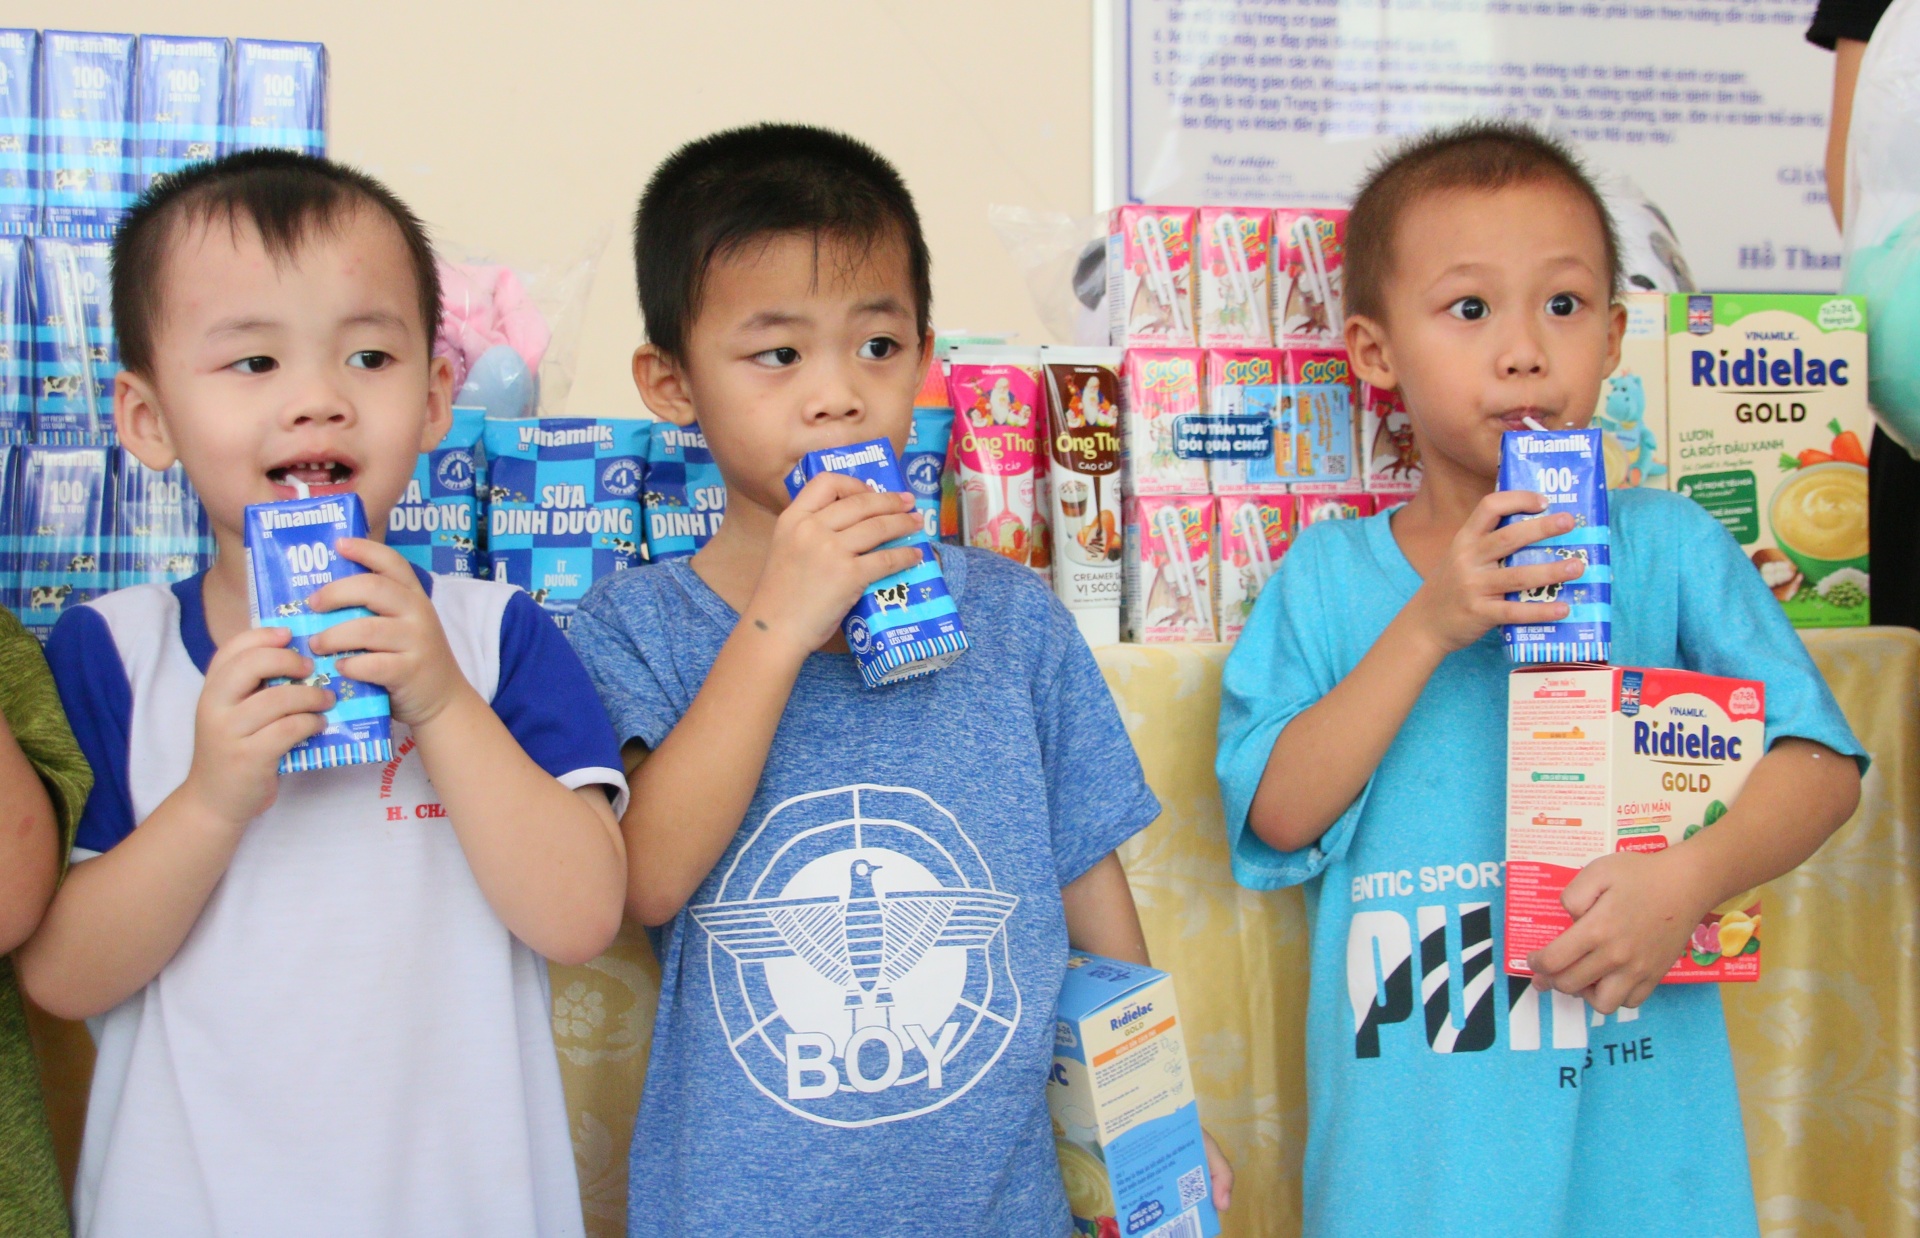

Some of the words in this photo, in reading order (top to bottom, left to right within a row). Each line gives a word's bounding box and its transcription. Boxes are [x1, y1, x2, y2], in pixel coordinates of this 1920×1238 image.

[53, 34, 124, 55] Vinamilk
[151, 39, 217, 58] Vinamilk
[246, 44, 313, 62] Vinamilk
[1691, 347, 1849, 387] Ridielac
[1735, 402, 1807, 423] GOLD
[518, 425, 613, 447] Vinamilk
[661, 430, 708, 448] Vina
[961, 430, 1004, 460] Ông
[1056, 430, 1098, 460] Ông
[1517, 434, 1592, 454] Vinamilk
[32, 451, 100, 467] Vinamilk
[821, 444, 887, 472] Vinamilk
[50, 480, 90, 504] 100%
[147, 481, 187, 504] 100%
[1537, 467, 1580, 493] 100%
[541, 482, 586, 509] SỮA
[695, 485, 727, 511] SỮ
[259, 502, 347, 530] Vinamilk
[389, 503, 471, 532] DƯỠNG
[492, 510, 548, 536] DINH
[552, 506, 633, 535] DƯỠNG
[651, 513, 707, 540] DINH
[287, 541, 337, 574] 100%
[1634, 720, 1742, 761] Ridielac
[1661, 771, 1711, 793] GOLD
[386, 806, 408, 821] H.
[1352, 869, 1413, 903] ENTIC
[1110, 1002, 1153, 1031] Ridielac
[1124, 1022, 1144, 1037] GOLD
[785, 1022, 961, 1100] BOY
[1603, 1037, 1654, 1066] THE
